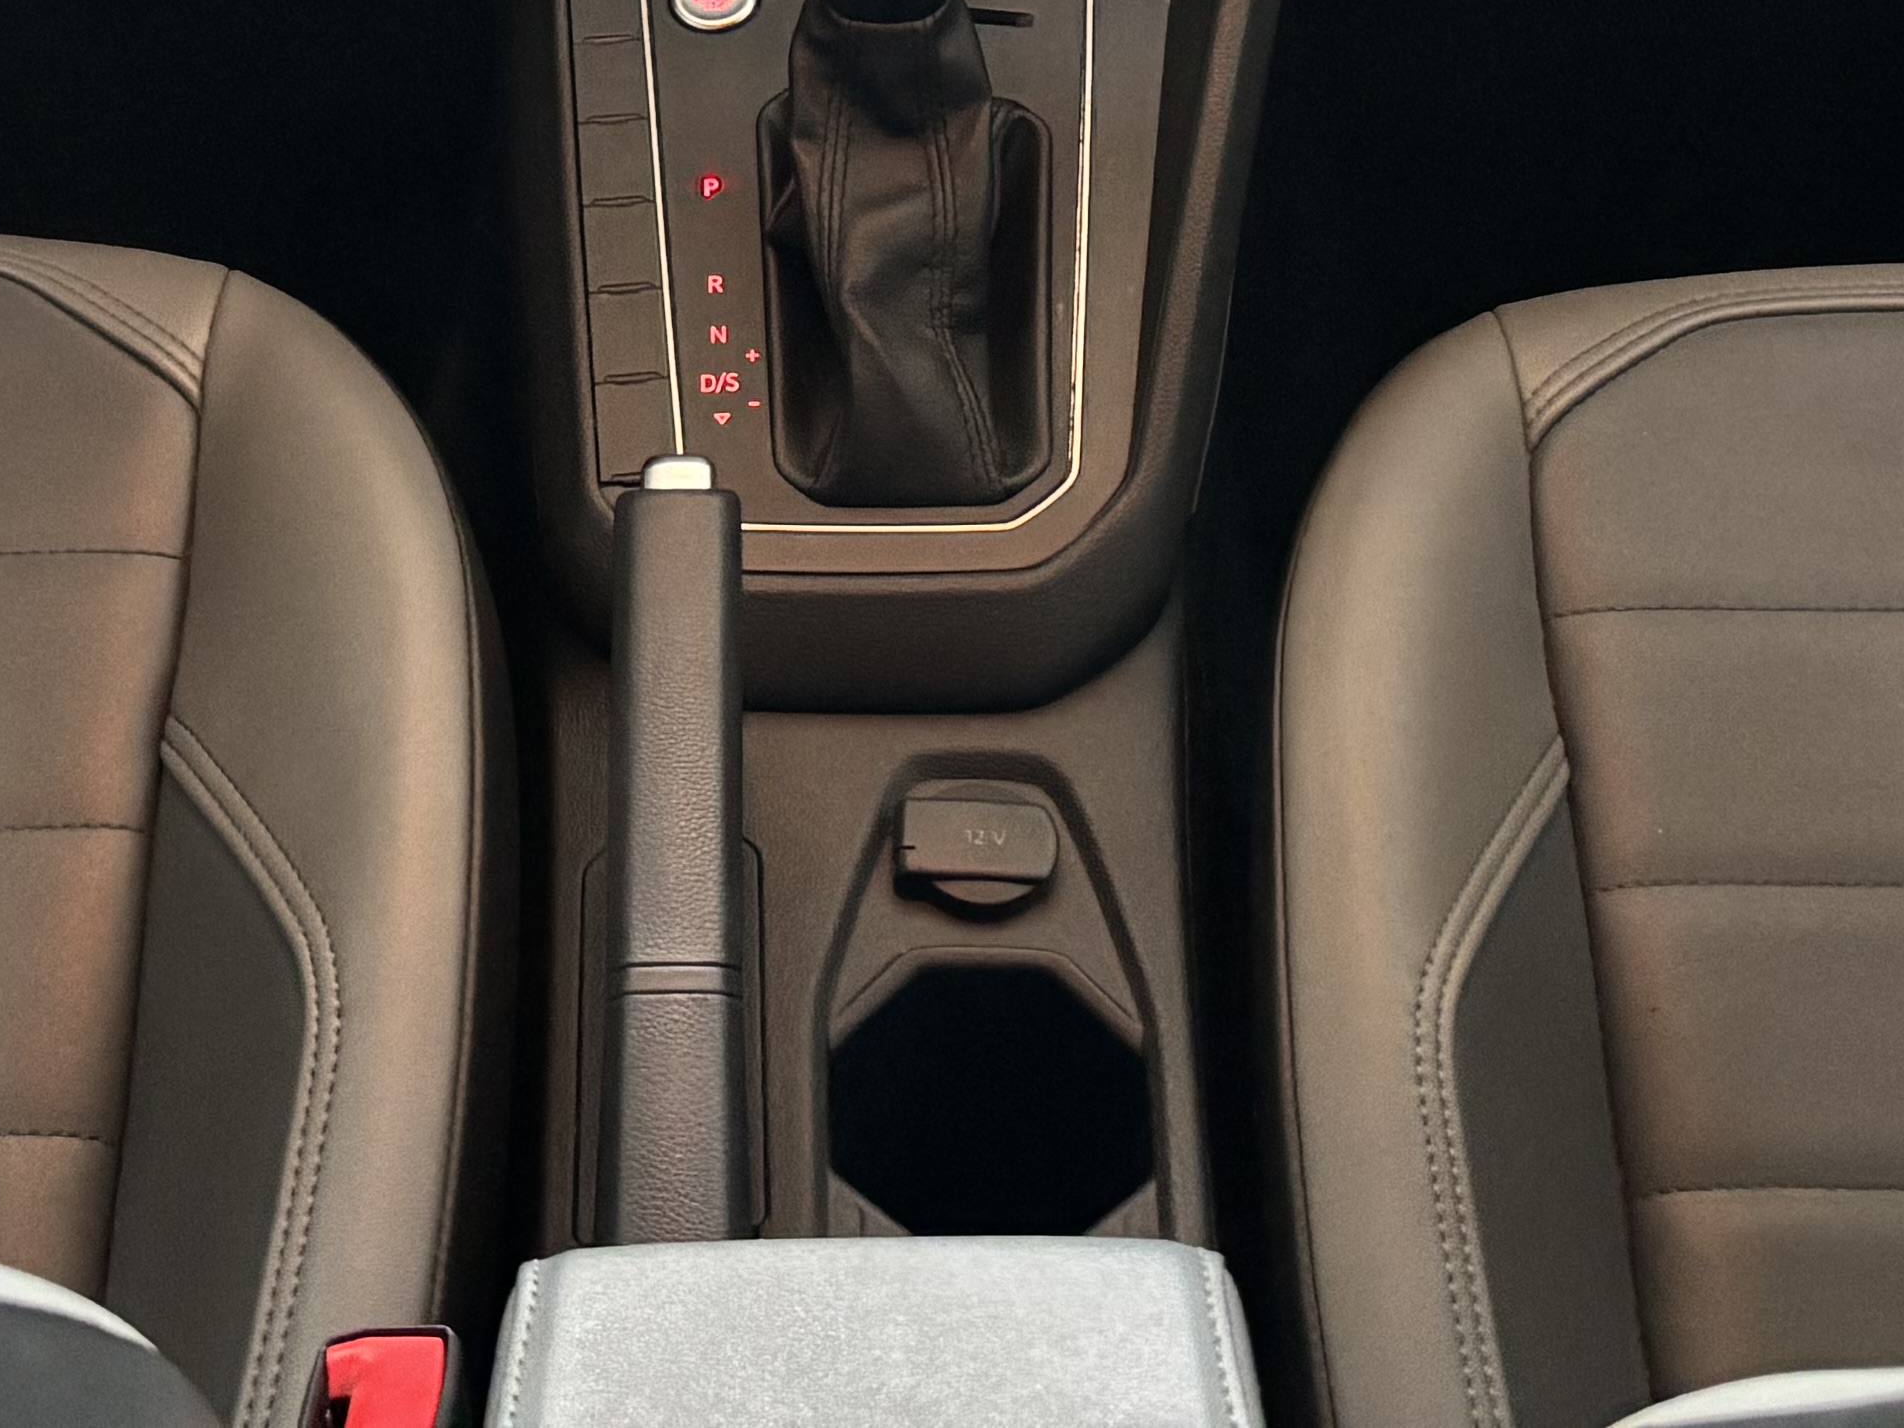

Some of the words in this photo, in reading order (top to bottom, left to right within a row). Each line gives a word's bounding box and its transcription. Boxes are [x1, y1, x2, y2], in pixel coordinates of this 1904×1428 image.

[703, 178, 719, 196] P
[707, 276, 724, 294] R
[710, 326, 727, 344] N
[700, 373, 739, 393] D/S
